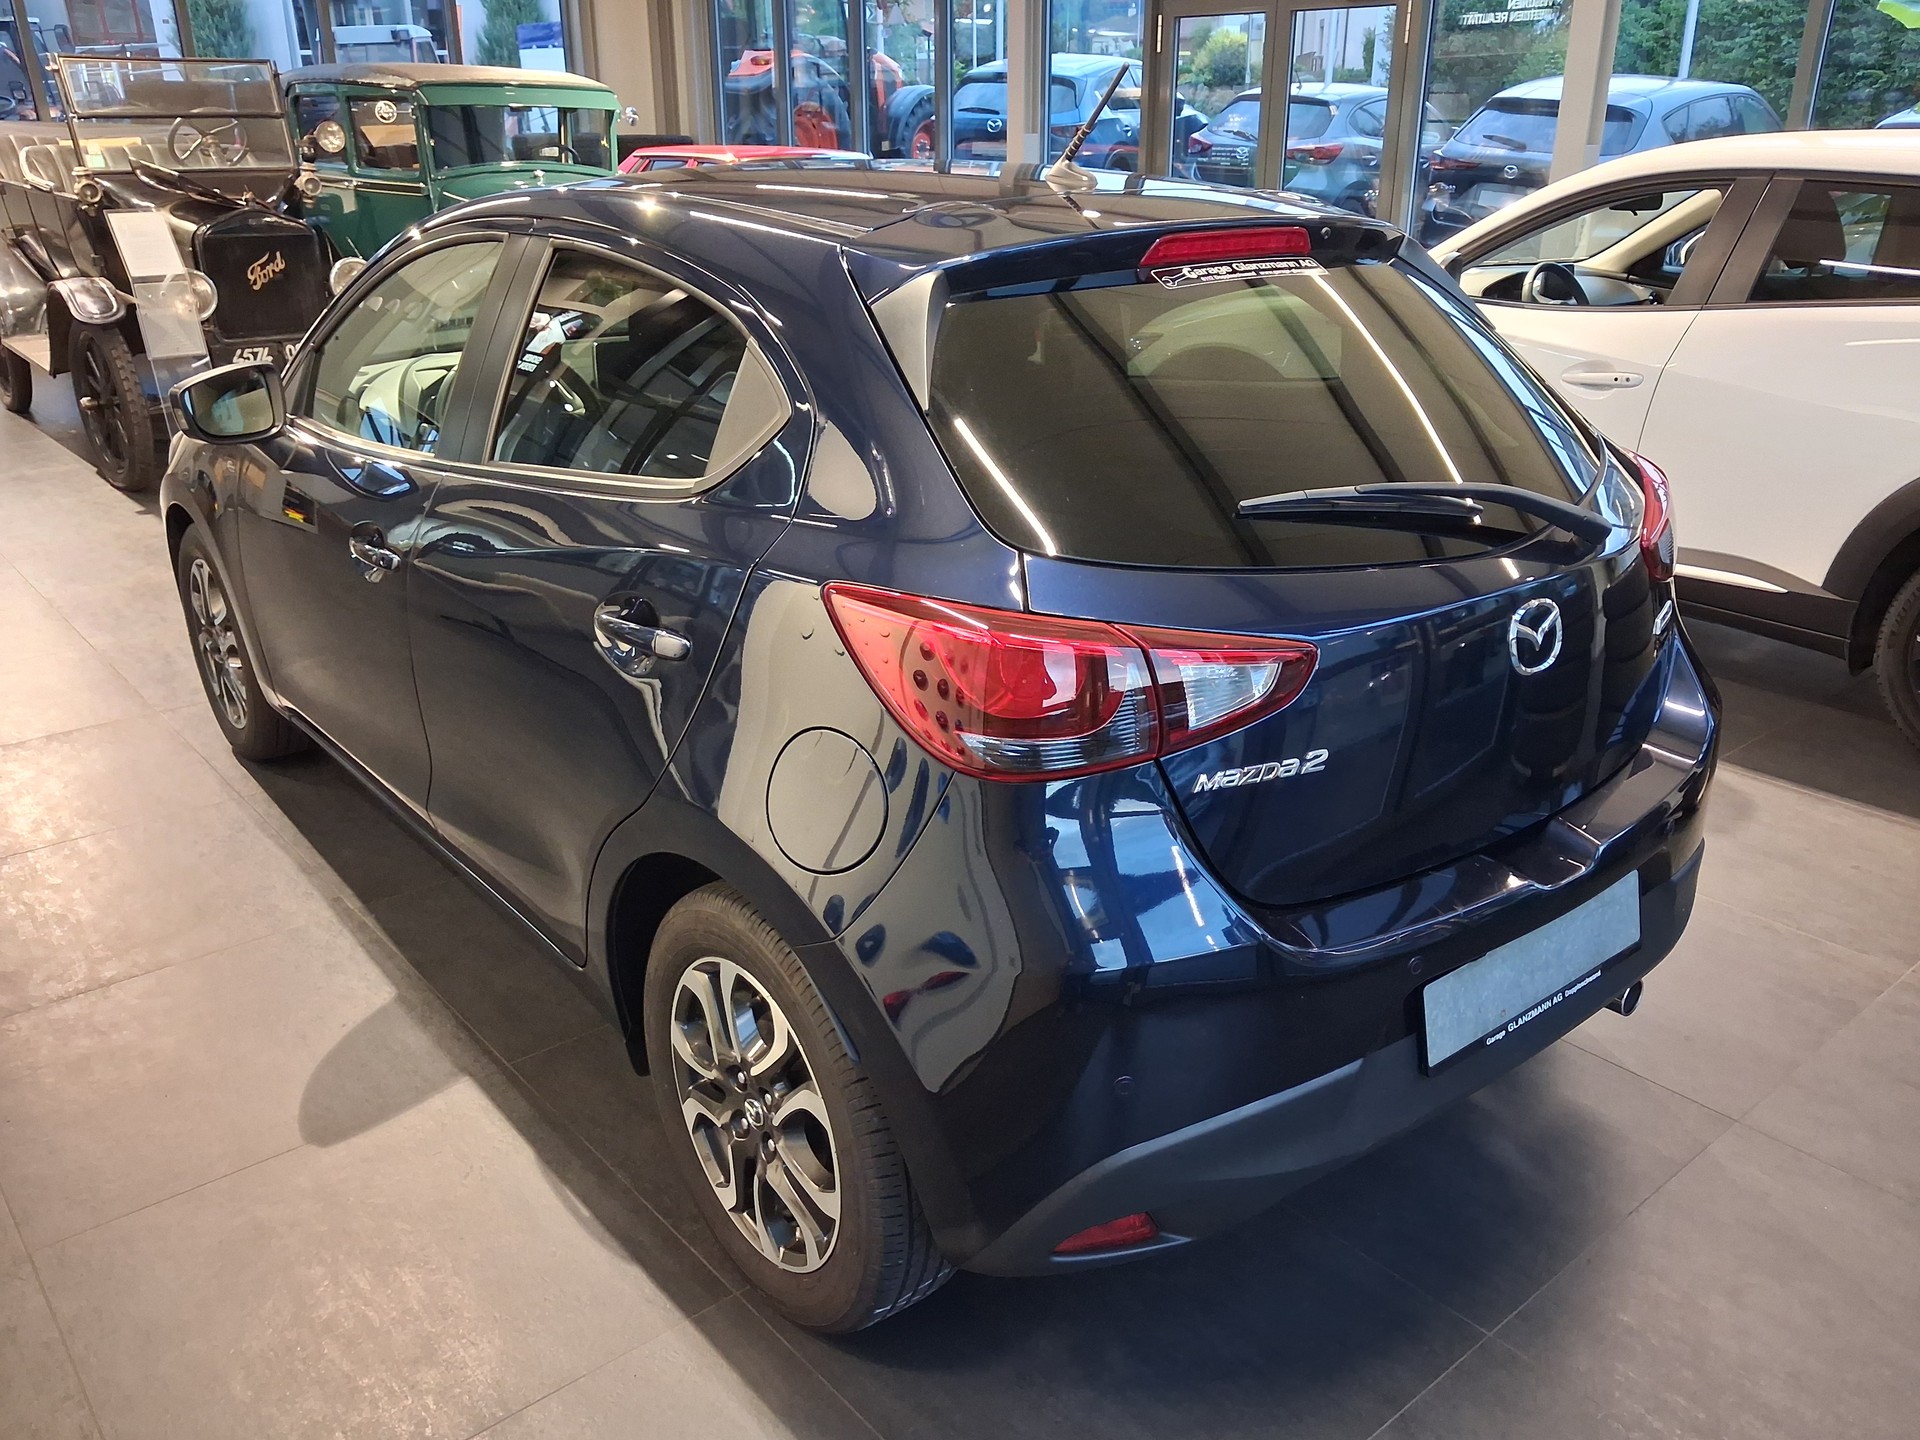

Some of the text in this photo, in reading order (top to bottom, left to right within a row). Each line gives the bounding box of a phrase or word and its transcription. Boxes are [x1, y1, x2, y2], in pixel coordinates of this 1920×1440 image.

[247, 251, 286, 291] Ford
[1183, 259, 1318, 278] Garage Glanzmann AG
[232, 346, 274, 364] 4574
[1486, 1030, 1506, 1046] Garage
[1507, 999, 1553, 1032] GLANZMANN
[1552, 993, 1563, 1005] AG
